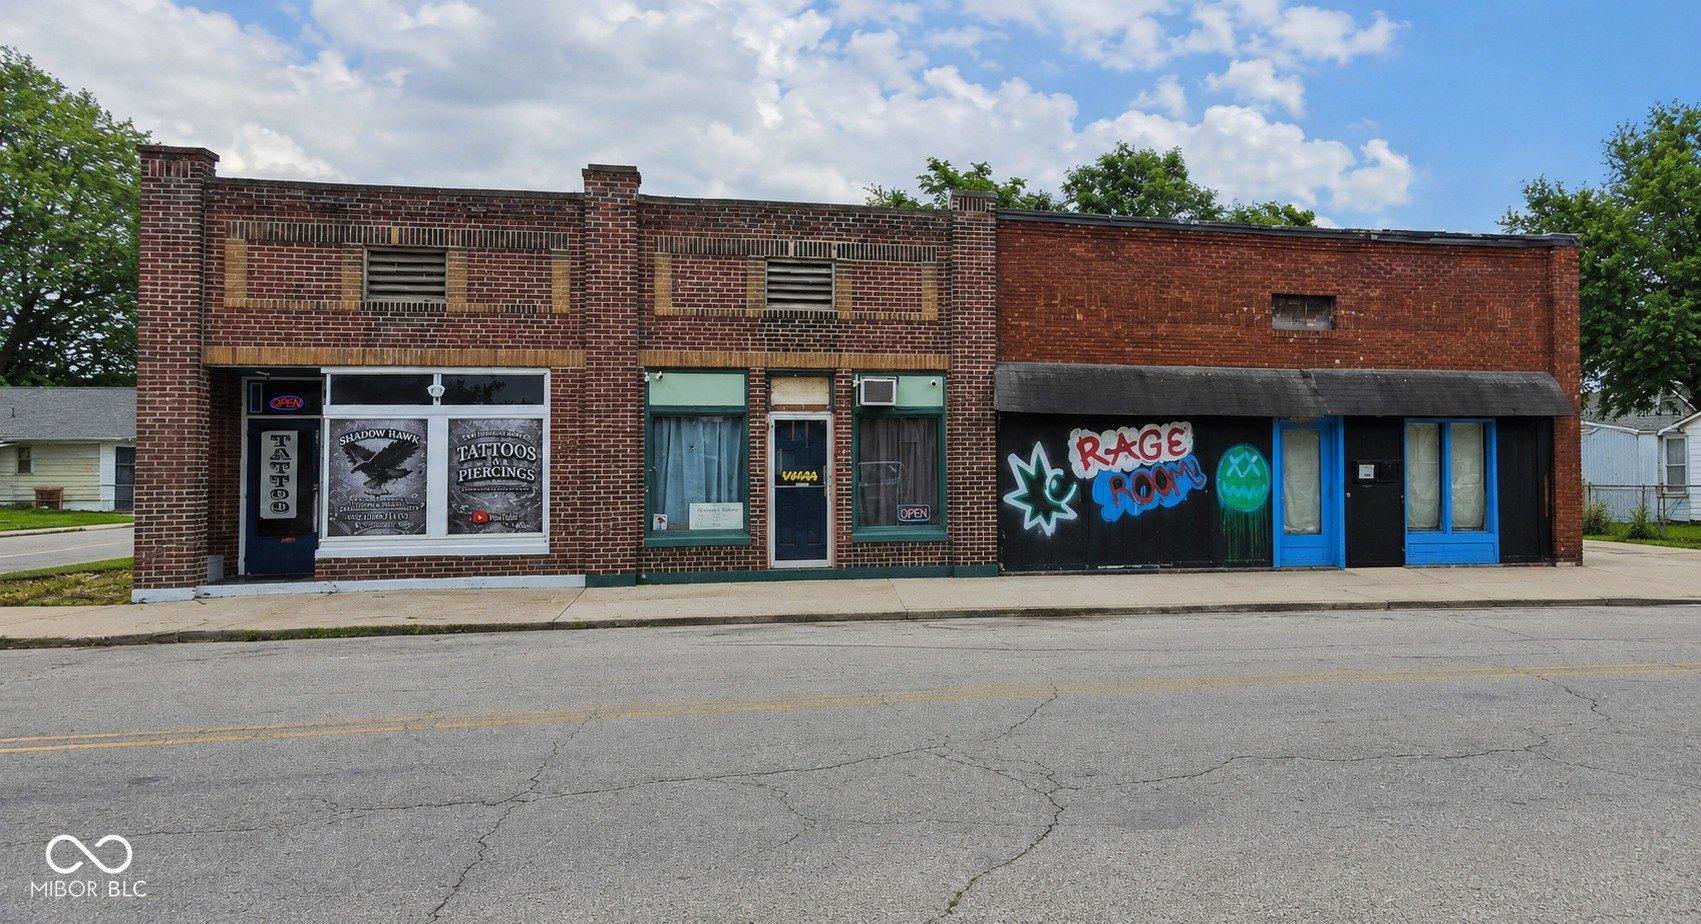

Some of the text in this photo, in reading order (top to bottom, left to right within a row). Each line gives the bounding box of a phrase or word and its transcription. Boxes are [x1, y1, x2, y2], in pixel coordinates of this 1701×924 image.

[339, 429, 419, 446] SHADOW HAWK
[457, 442, 536, 462] TATTOOS
[1075, 427, 1187, 471] RAGE
[270, 434, 292, 514] TATTOO
[458, 466, 535, 482] PIERCINGS
[900, 508, 927, 519] OPEN
